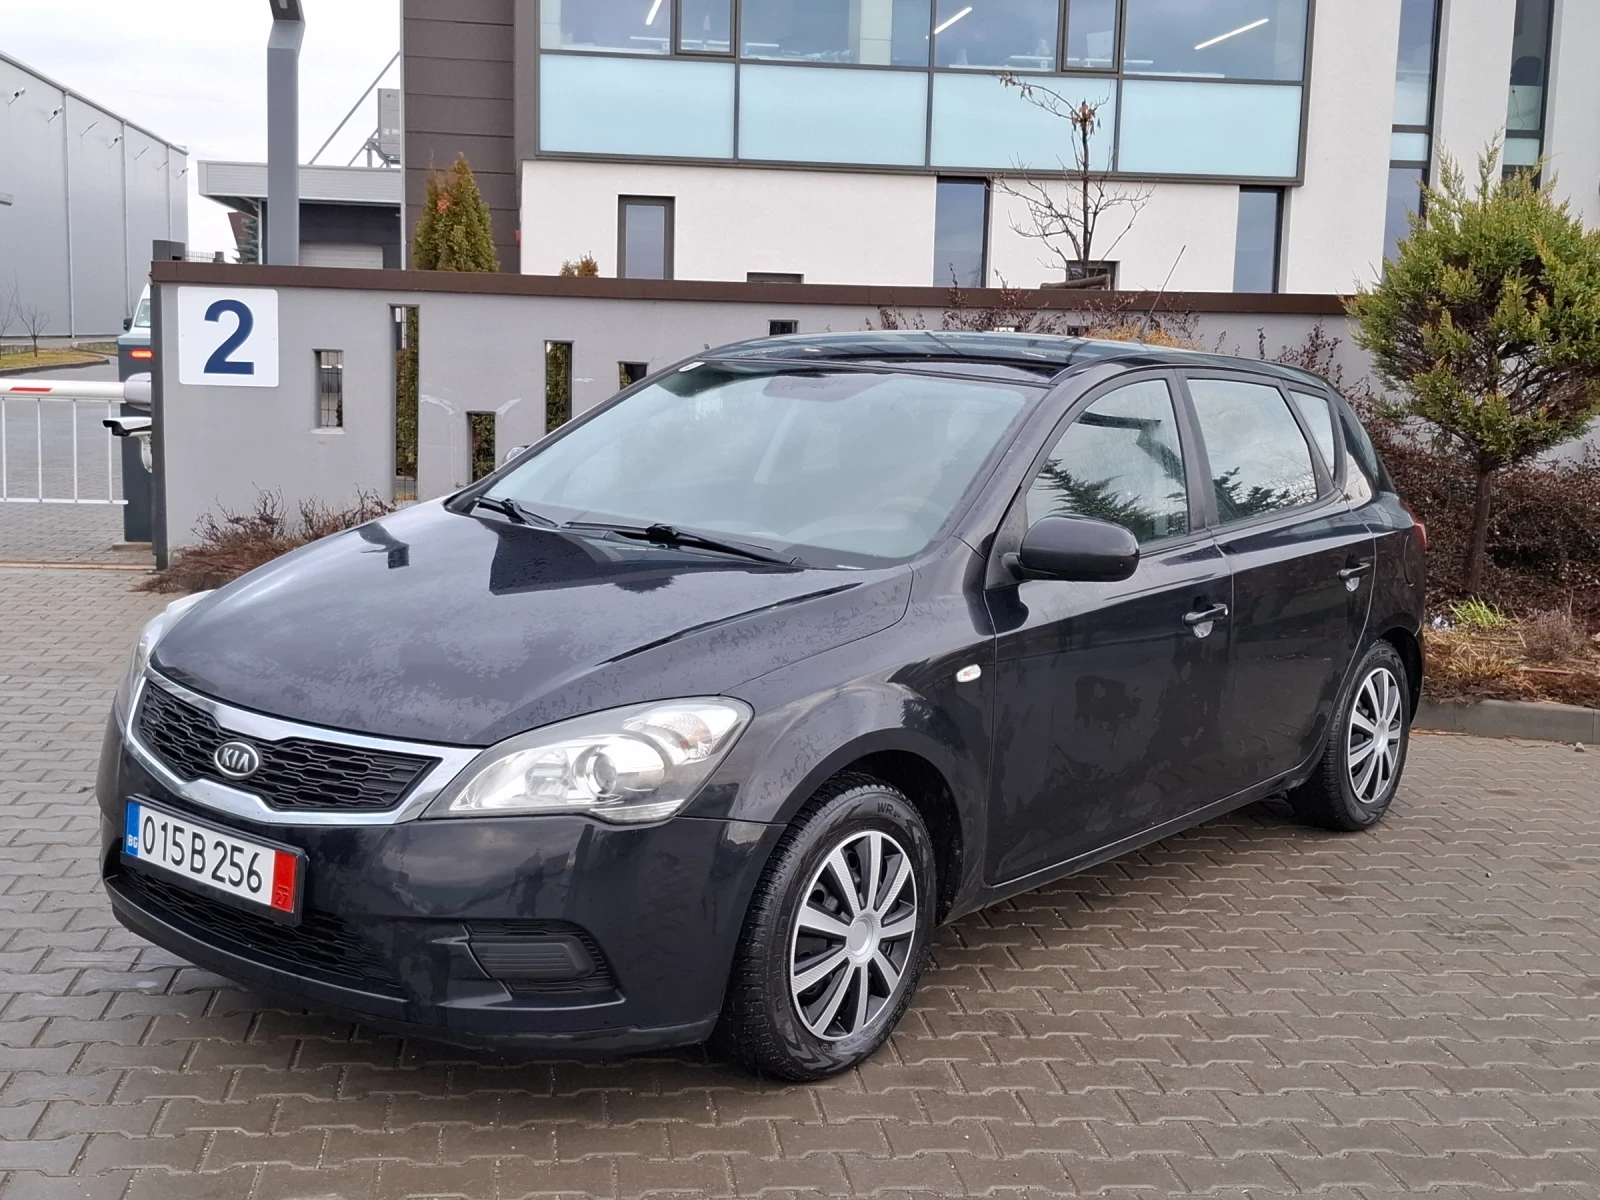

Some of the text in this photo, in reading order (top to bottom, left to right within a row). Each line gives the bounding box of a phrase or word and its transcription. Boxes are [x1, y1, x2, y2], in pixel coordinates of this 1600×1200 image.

[203, 298, 255, 375] 2
[220, 747, 250, 772] KIA
[128, 834, 139, 849] BG
